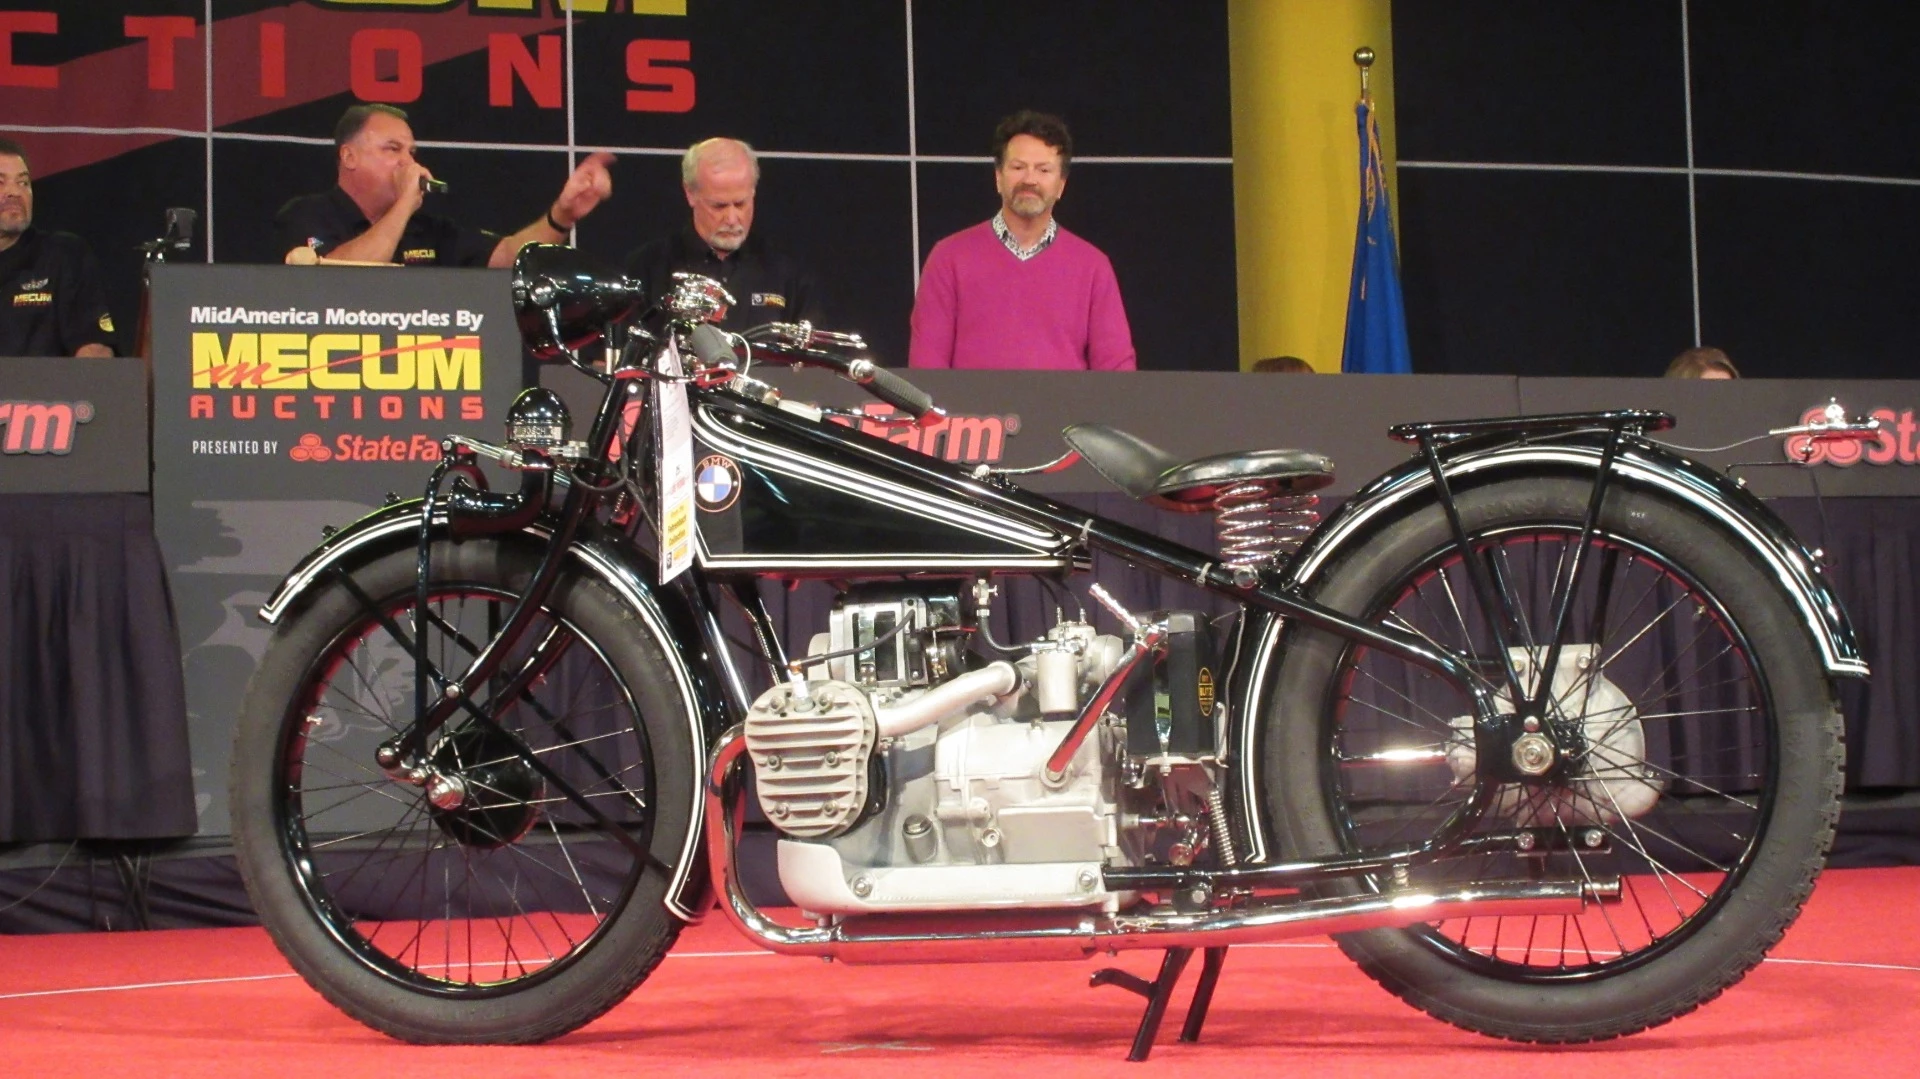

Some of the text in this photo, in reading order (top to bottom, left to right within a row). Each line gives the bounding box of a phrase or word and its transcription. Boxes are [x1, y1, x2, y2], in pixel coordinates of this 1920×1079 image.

[190, 306, 484, 332] MidAmerica Motorcycles By
[191, 332, 482, 391] MECUM
[189, 394, 484, 420] AUCTIONS
[192, 440, 260, 455] PRESENTED
[263, 441, 278, 456] BY
[1868, 408, 1920, 462] St
[702, 457, 732, 470] BMW
